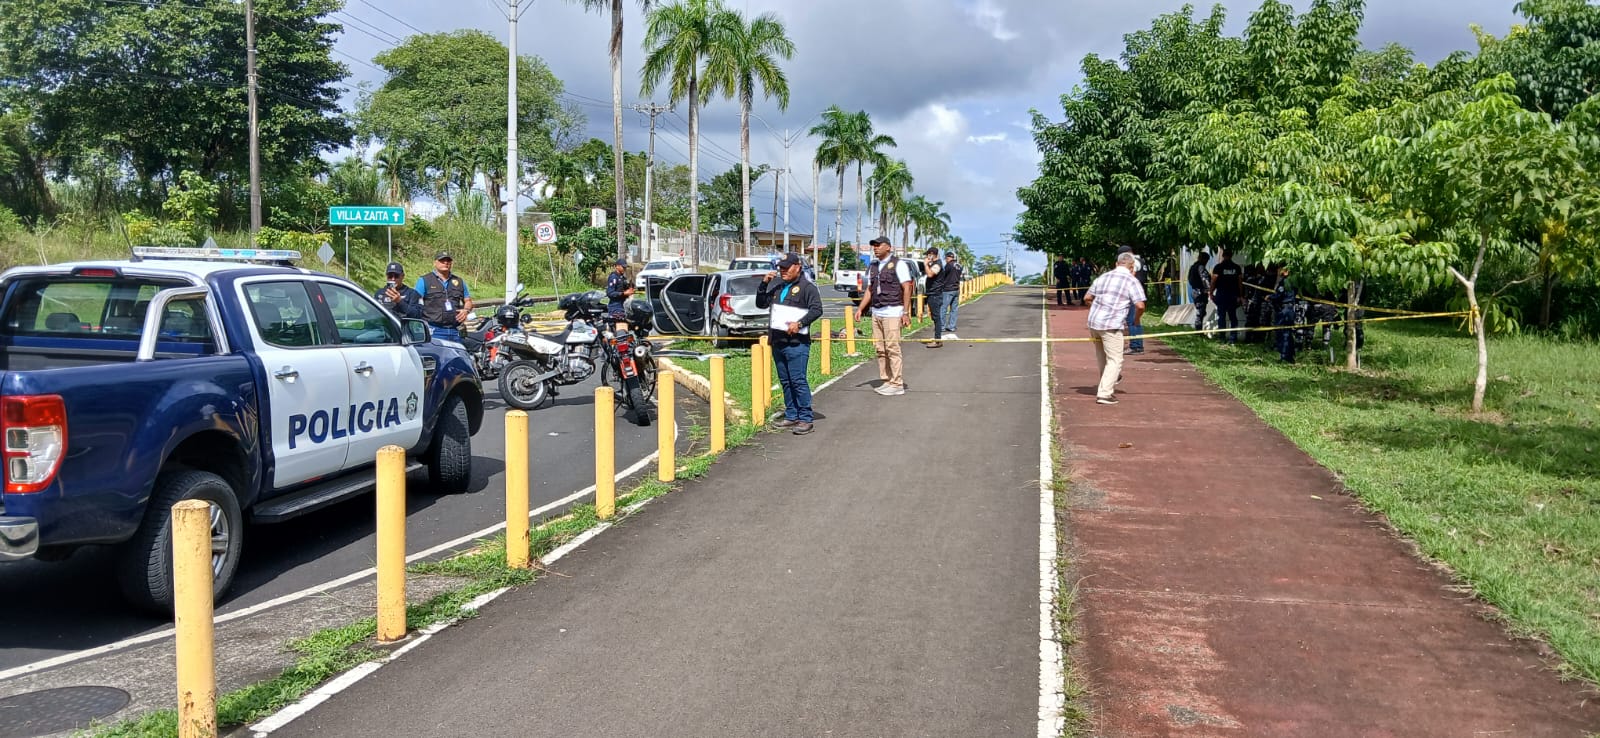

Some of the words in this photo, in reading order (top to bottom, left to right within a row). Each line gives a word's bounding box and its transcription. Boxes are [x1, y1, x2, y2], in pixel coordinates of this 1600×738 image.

[336, 210, 362, 221] VILLA
[363, 210, 389, 221] ZAITA
[288, 397, 401, 449] POLICIA
